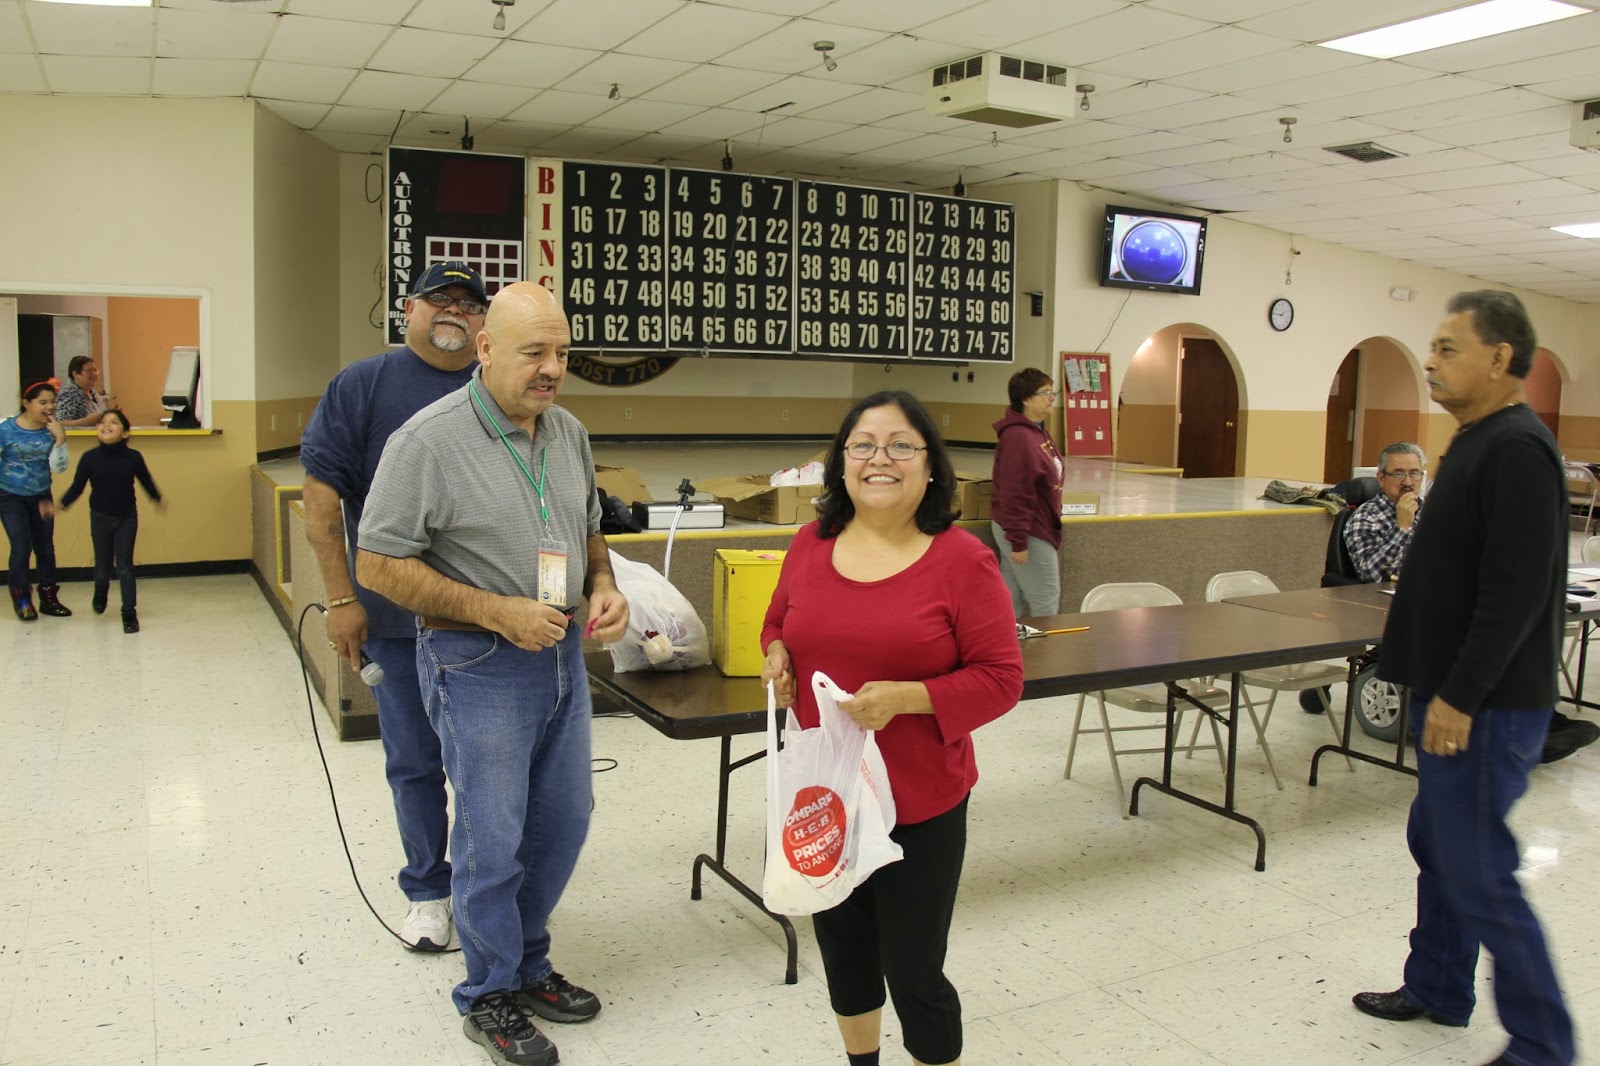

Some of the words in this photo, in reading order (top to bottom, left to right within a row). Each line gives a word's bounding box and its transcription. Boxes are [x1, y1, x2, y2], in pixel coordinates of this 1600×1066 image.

[577, 171, 585, 196] 1
[611, 173, 621, 199] 2
[645, 175, 655, 201] 3
[678, 177, 689, 202] 4
[711, 179, 720, 204] 5
[742, 182, 752, 207] 6
[773, 186, 782, 209] 7
[808, 189, 817, 213] 8
[837, 192, 846, 216] 9
[861, 195, 877, 219] 10
[890, 198, 904, 221] 11
[918, 201, 933, 225] 12
[944, 204, 959, 228] 13
[969, 207, 984, 230] 14
[994, 210, 1009, 232] 15
[572, 206, 592, 233] 16
[606, 208, 626, 234] 17
[640, 210, 659, 236] 18
[673, 211, 692, 237] 19
[703, 213, 726, 239] 20
[736, 216, 756, 241] 21
[766, 218, 788, 244] 22
[802, 221, 822, 247] 23
[831, 224, 850, 249] 24
[859, 226, 878, 251] 25
[886, 229, 906, 253] 26
[915, 232, 934, 256] 27
[941, 235, 959, 259] 28
[967, 237, 985, 261] 29
[992, 240, 1010, 263] 30
[572, 242, 592, 269] 31
[604, 243, 628, 270] 32
[638, 245, 661, 271] 33
[671, 245, 694, 272] 34
[703, 247, 725, 274] 35
[735, 250, 757, 276] 36
[766, 252, 787, 277] 37
[801, 254, 821, 280] 38
[830, 256, 850, 282] 39
[858, 259, 878, 284] 40
[887, 261, 904, 285] 41
[915, 264, 934, 288] 42
[941, 267, 959, 290] 43
[966, 269, 985, 292] 44
[991, 271, 1009, 294] 45
[389, 311, 406, 319] Bin
[570, 278, 594, 305] 46
[604, 279, 628, 305] 47
[638, 281, 662, 307] 48
[671, 281, 694, 307] 49
[703, 282, 725, 308] 50
[736, 284, 755, 309] 51
[766, 285, 787, 311] 52
[801, 288, 821, 313] 53
[830, 289, 850, 314] 54
[858, 291, 878, 316] 55
[886, 293, 905, 317] 56
[915, 296, 933, 319] 57
[941, 297, 959, 321] 58
[966, 299, 984, 323] 59
[991, 301, 1009, 324] 60
[572, 314, 593, 341] 61
[605, 314, 629, 341] 62
[638, 315, 662, 342] 63
[671, 315, 693, 341] 64
[703, 317, 725, 344] 65
[734, 318, 756, 344] 66
[765, 319, 787, 344] 67
[801, 321, 822, 346] 68
[830, 322, 850, 347] 69
[858, 324, 878, 348] 70
[887, 326, 904, 349] 71
[915, 327, 933, 351] 72
[941, 329, 959, 353] 73
[966, 330, 984, 353] 74
[991, 332, 1009, 355] 75
[569, 355, 616, 383] POST
[625, 357, 661, 383] 770
[786, 792, 833, 826] OMPARE
[792, 825, 840, 862] PRICES
[797, 861, 811, 871] TO
[812, 834, 844, 867] ANYONE
